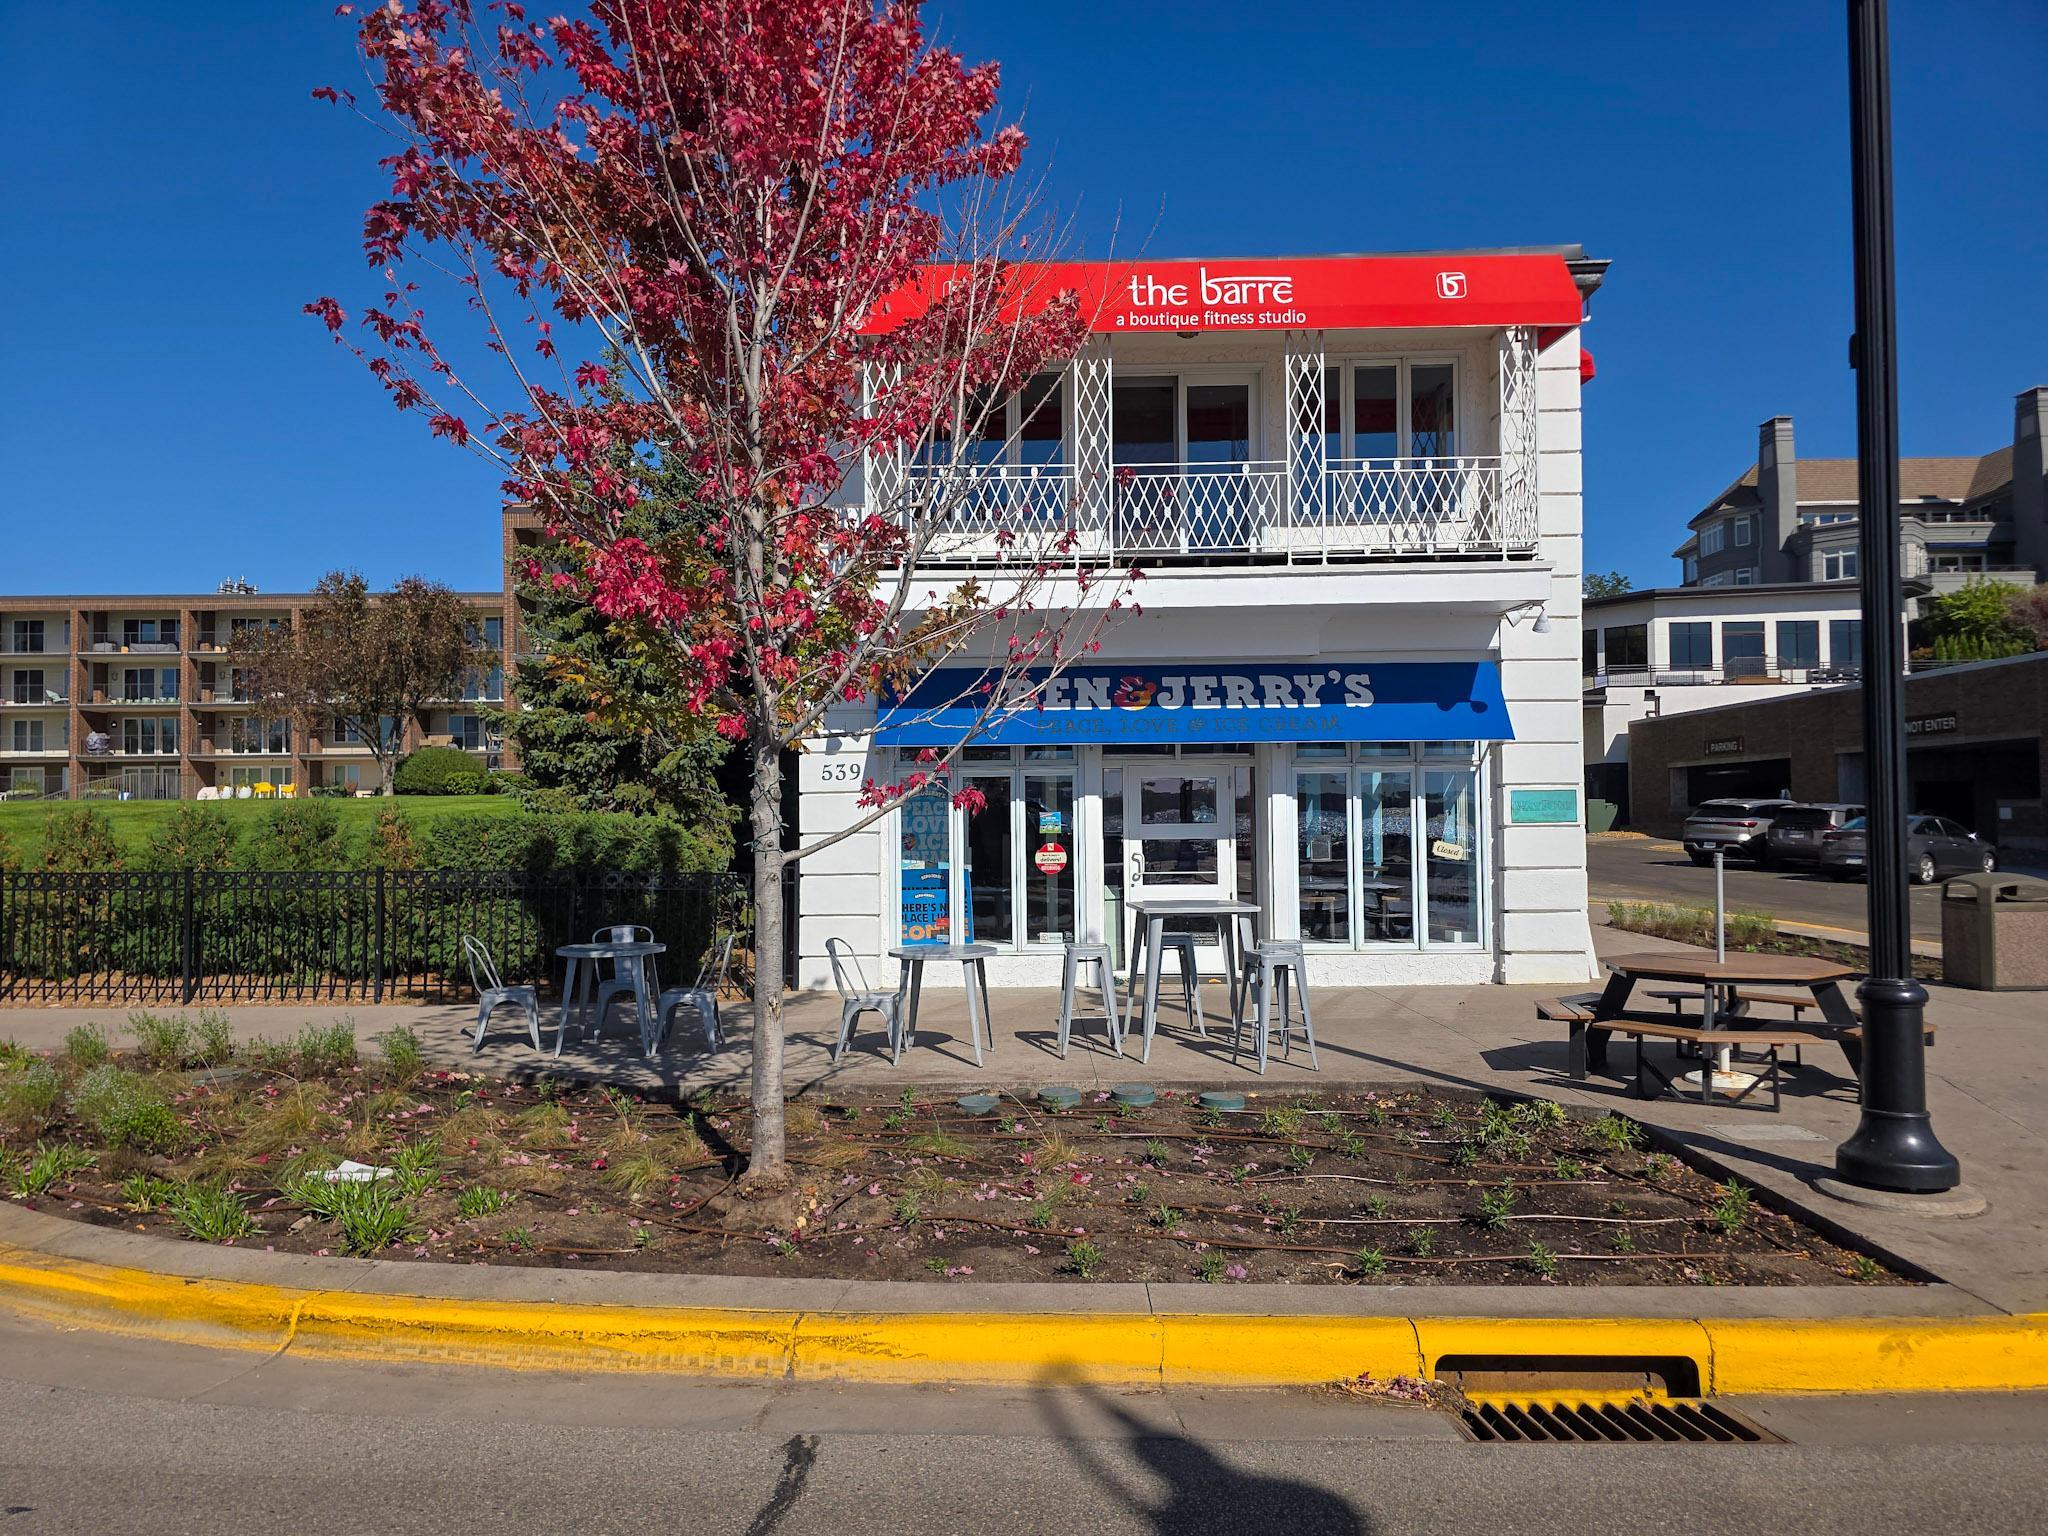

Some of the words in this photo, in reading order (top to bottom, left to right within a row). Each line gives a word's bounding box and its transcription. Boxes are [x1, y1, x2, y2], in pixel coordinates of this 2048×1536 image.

[1128, 275, 1188, 305] the
[1200, 267, 1293, 305] barre
[1116, 316, 1125, 326] a
[1130, 312, 1199, 328] boutique
[1204, 311, 1254, 325] fitness
[1258, 309, 1307, 324] studio
[1003, 677, 1112, 711] BEN
[1157, 669, 1375, 710] JERRY'S
[1122, 717, 1178, 734] LOVE
[1214, 716, 1249, 733] ICE
[1259, 714, 1343, 735] CREAM
[1925, 716, 1956, 731] ENTER
[1710, 741, 1737, 752] PARKING
[821, 763, 861, 781] 539
[1436, 844, 1460, 856] Closed
